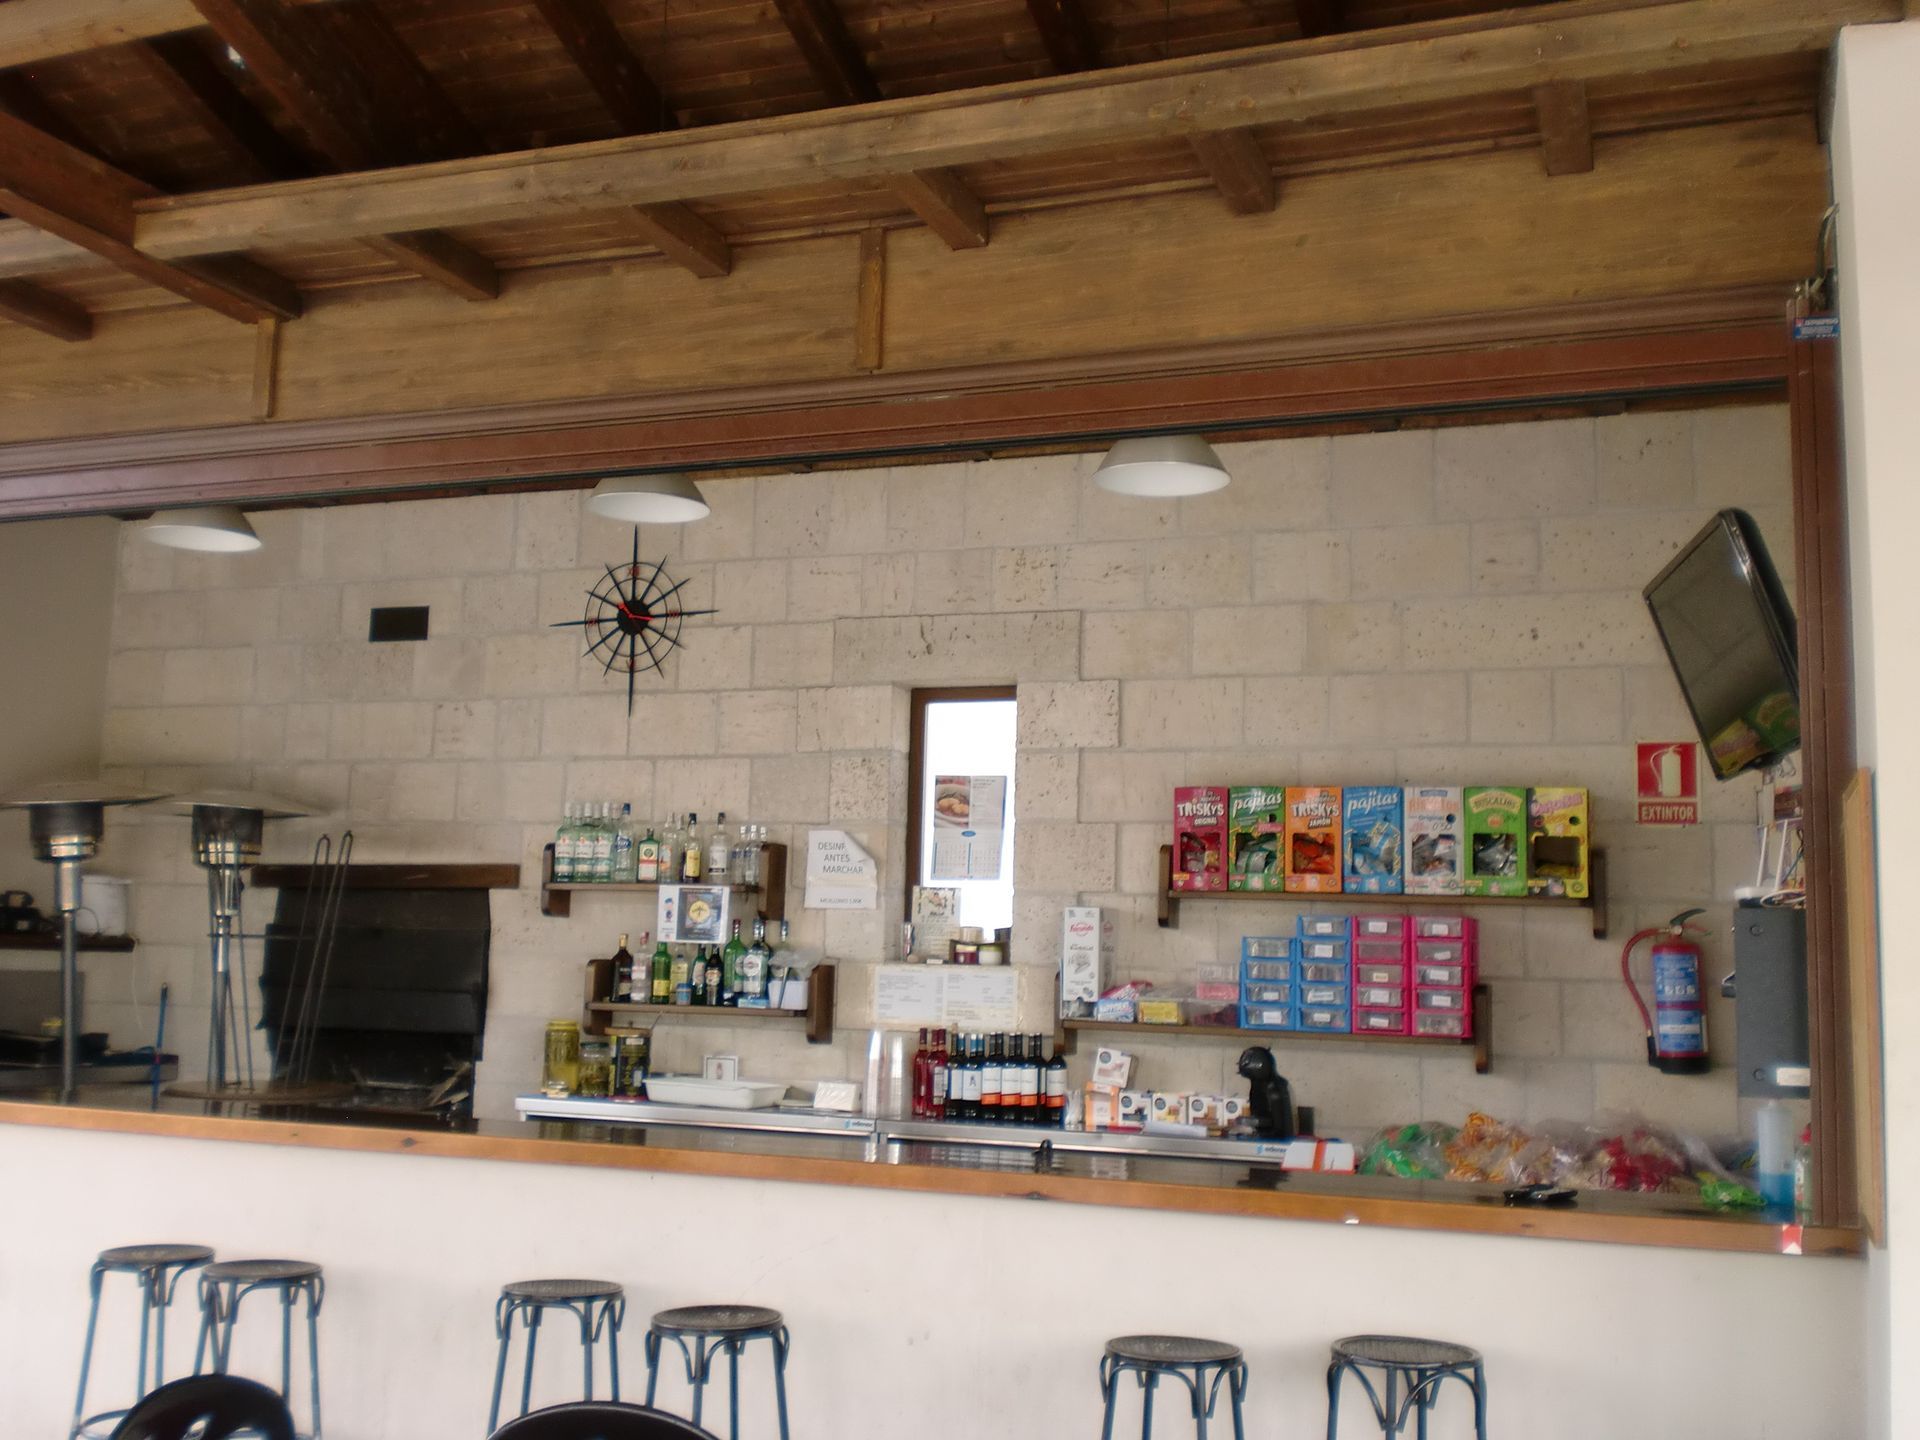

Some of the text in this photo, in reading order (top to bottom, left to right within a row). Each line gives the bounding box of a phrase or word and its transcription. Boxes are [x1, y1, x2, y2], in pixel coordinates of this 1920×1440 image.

[1232, 788, 1282, 818] pajitas
[1347, 790, 1399, 818] pajitas
[1641, 806, 1694, 820] EXTINTOR
[823, 854, 850, 863] ANTES
[822, 865, 864, 874] MARCHAR
